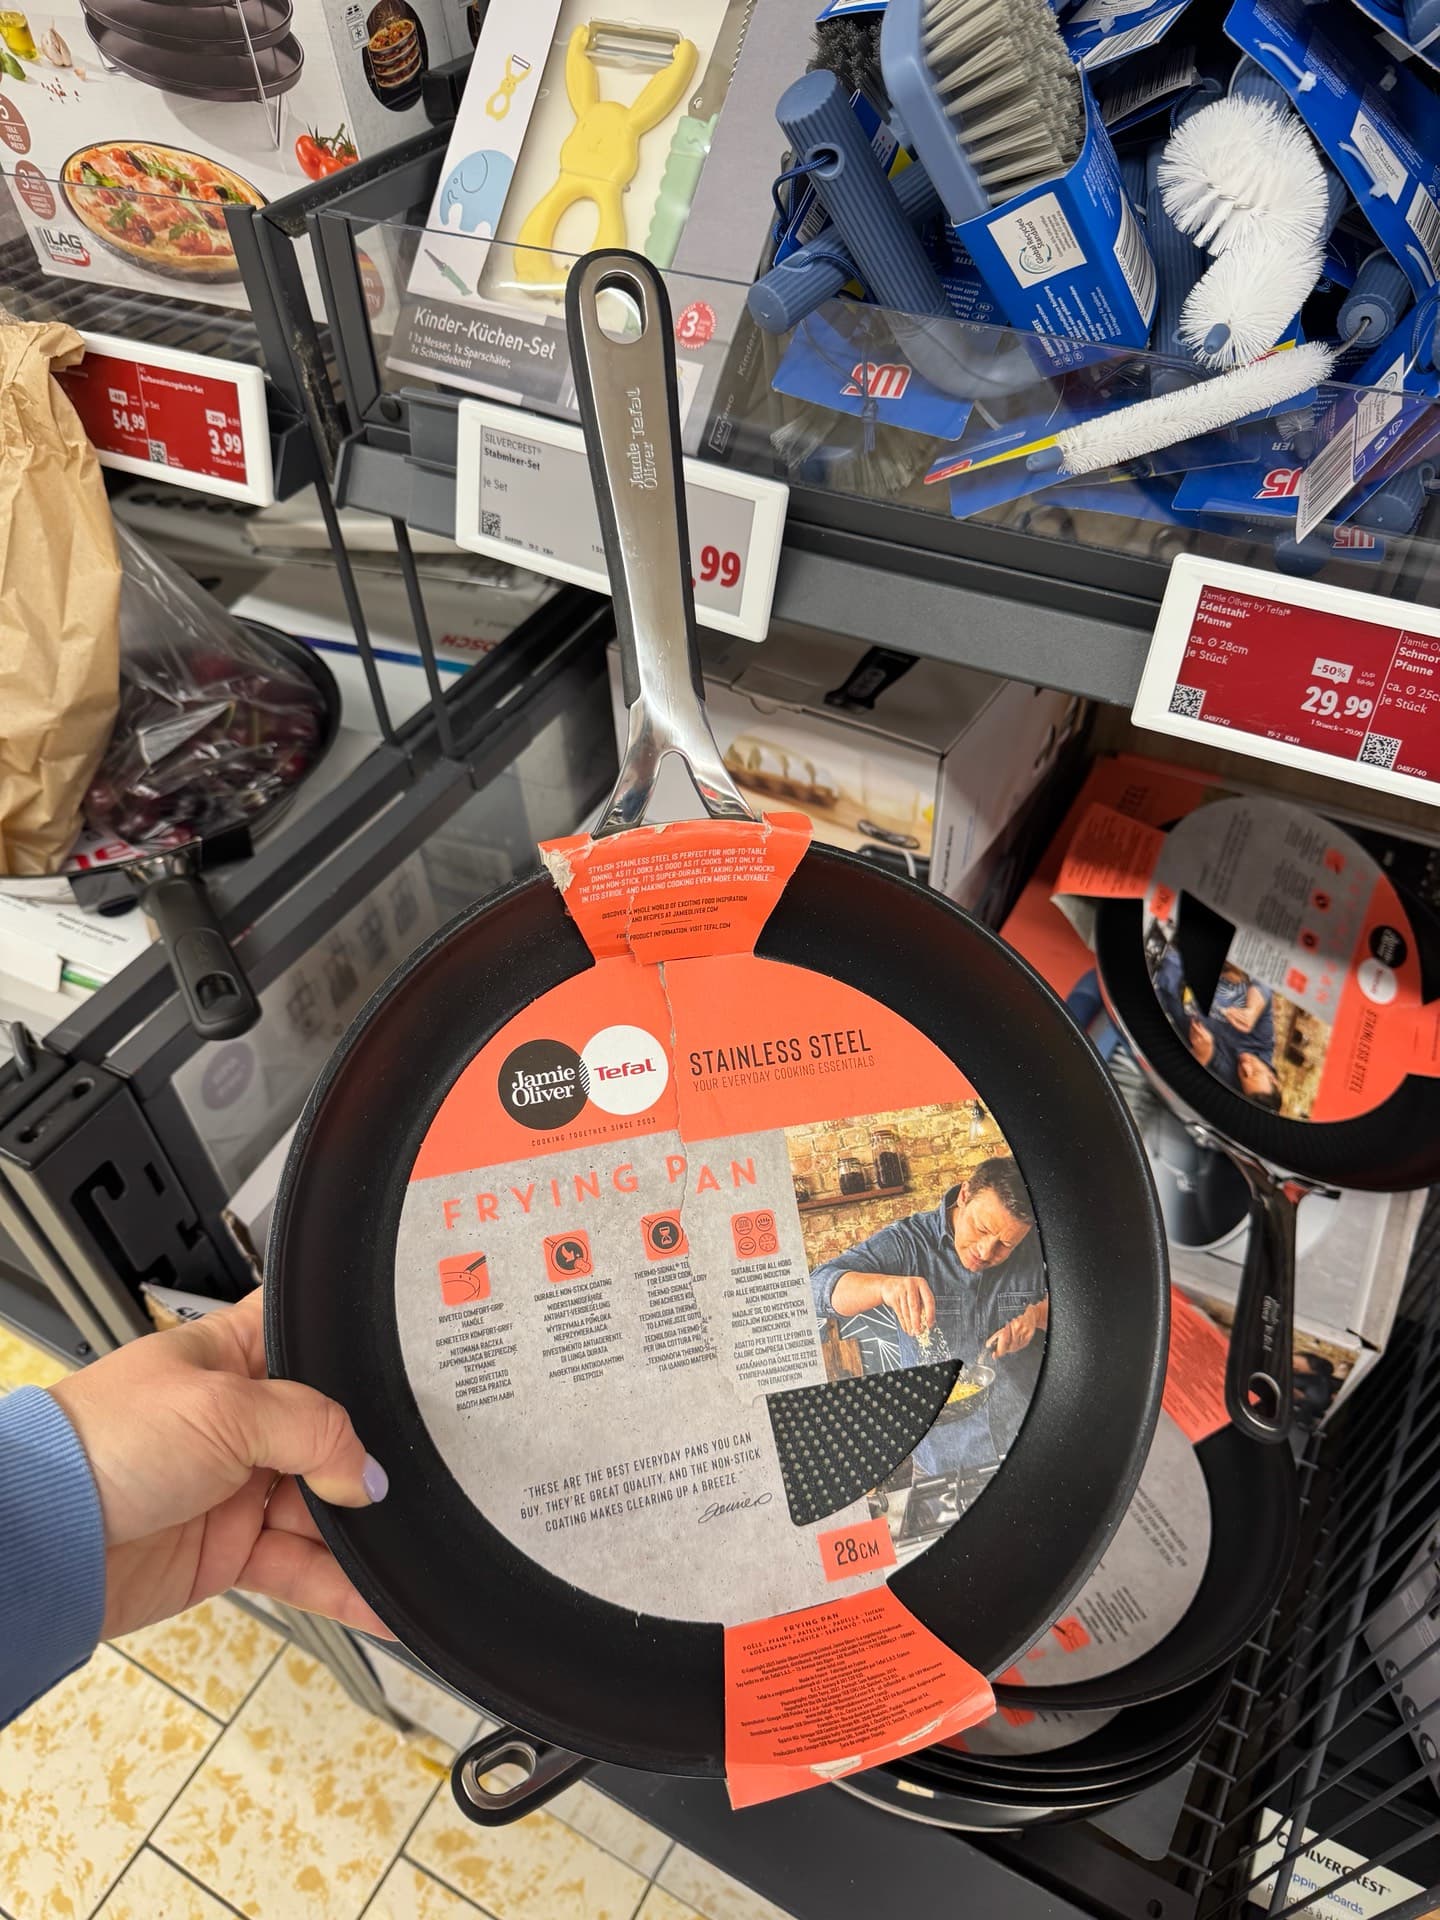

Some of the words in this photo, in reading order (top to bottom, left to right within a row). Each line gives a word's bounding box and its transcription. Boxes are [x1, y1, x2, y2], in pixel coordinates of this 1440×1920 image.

[43, 228, 82, 249] ILAG
[1026, 221, 1045, 249] Standard
[414, 306, 557, 360] Kinder-Küchen-Set
[420, 346, 472, 369] Schneidebrett
[424, 336, 451, 351] Messer,
[464, 346, 512, 369] Sparschäler,
[112, 409, 146, 432] 54.99
[208, 429, 242, 457] 3.99
[484, 448, 540, 471] Stabmixer-Set
[626, 442, 645, 490] Jamie
[643, 441, 658, 490] Oliver
[494, 478, 508, 492] Set
[1200, 601, 1250, 619] Edelstahl-
[1203, 590, 1226, 603] Jamie
[1228, 595, 1252, 608] Oliver
[1254, 602, 1265, 613] by
[1196, 613, 1233, 629] Pfanne
[1190, 635, 1205, 645] ca.
[1219, 640, 1248, 655] 28cm
[1403, 635, 1429, 649] Jamie
[1185, 646, 1196, 658] je
[1199, 650, 1228, 665] Stück
[1316, 664, 1347, 678] -50%
[1394, 659, 1434, 676] Pfanne
[1386, 682, 1402, 693] ca.
[1300, 685, 1373, 719] 29.99
[1379, 693, 1392, 706] je
[1395, 697, 1428, 714] Stück
[588, 864, 614, 874] STYLISH
[616, 857, 649, 870] STAINLESS
[651, 854, 669, 865] STEEL
[680, 850, 707, 860] PERFECT
[709, 848, 721, 857] FOR
[633, 865, 654, 876] LOOKS
[665, 862, 682, 872] GOOD
[739, 856, 756, 865] ONLY
[592, 883, 604, 893] PAN
[710, 865, 733, 874] TAKING
[735, 865, 748, 873] ANY
[750, 865, 775, 873] KNOCKS
[627, 886, 639, 896] AND
[641, 882, 664, 893] MAKING
[667, 878, 694, 889] COOKING
[696, 876, 712, 885] EVEN
[714, 874, 731, 883] MORE
[602, 909, 627, 920] DISCOVER
[633, 906, 650, 916] WHOLE
[651, 904, 669, 914] WORLD
[678, 899, 700, 910] EXCITING
[702, 897, 715, 906] FOOD
[716, 895, 748, 905] INSPIRATION
[643, 912, 663, 922] RECIPES
[630, 931, 652, 941] PRODUCT
[690, 924, 702, 933] VISIT
[704, 922, 731, 932] TEFAL.COM
[689, 1038, 802, 1076] STAINLESS
[809, 1029, 872, 1058] STEEL
[511, 1065, 576, 1092] Jamie
[593, 1058, 657, 1082] Tefal
[692, 1079, 719, 1093] YOUR
[722, 1069, 771, 1089] EVERYDAY
[774, 1064, 815, 1081] COOKING
[817, 1055, 875, 1076] ESSENTIALS
[512, 1082, 575, 1108] Oliver
[531, 1134, 566, 1147] COOKING
[569, 1126, 608, 1139] TOGETHER
[611, 1120, 633, 1133] SINCE
[443, 1162, 639, 1230] FRYING
[665, 1154, 757, 1194] PAN
[563, 1474, 582, 1489] ARE
[585, 1469, 604, 1483] THE
[606, 1462, 630, 1479] BEST
[634, 1450, 681, 1473] EVERYDAY
[685, 1443, 709, 1458] PANS
[711, 1437, 730, 1452] YOU
[733, 1432, 752, 1446] CAN
[520, 1504, 543, 1520] BUY.
[545, 1492, 586, 1514] THEY'RE
[590, 1483, 619, 1501] GREAT
[669, 1467, 688, 1482] AND
[692, 1462, 709, 1475] THE
[711, 1448, 761, 1470] NON-STICK
[545, 1514, 587, 1532] COATING
[591, 1504, 624, 1522] MAKES
[626, 1492, 673, 1512] CLEARING
[676, 1487, 689, 1499] UP
[692, 1483, 699, 1494] A
[784, 1618, 817, 1633] FRYING
[821, 1612, 840, 1623] PAN
